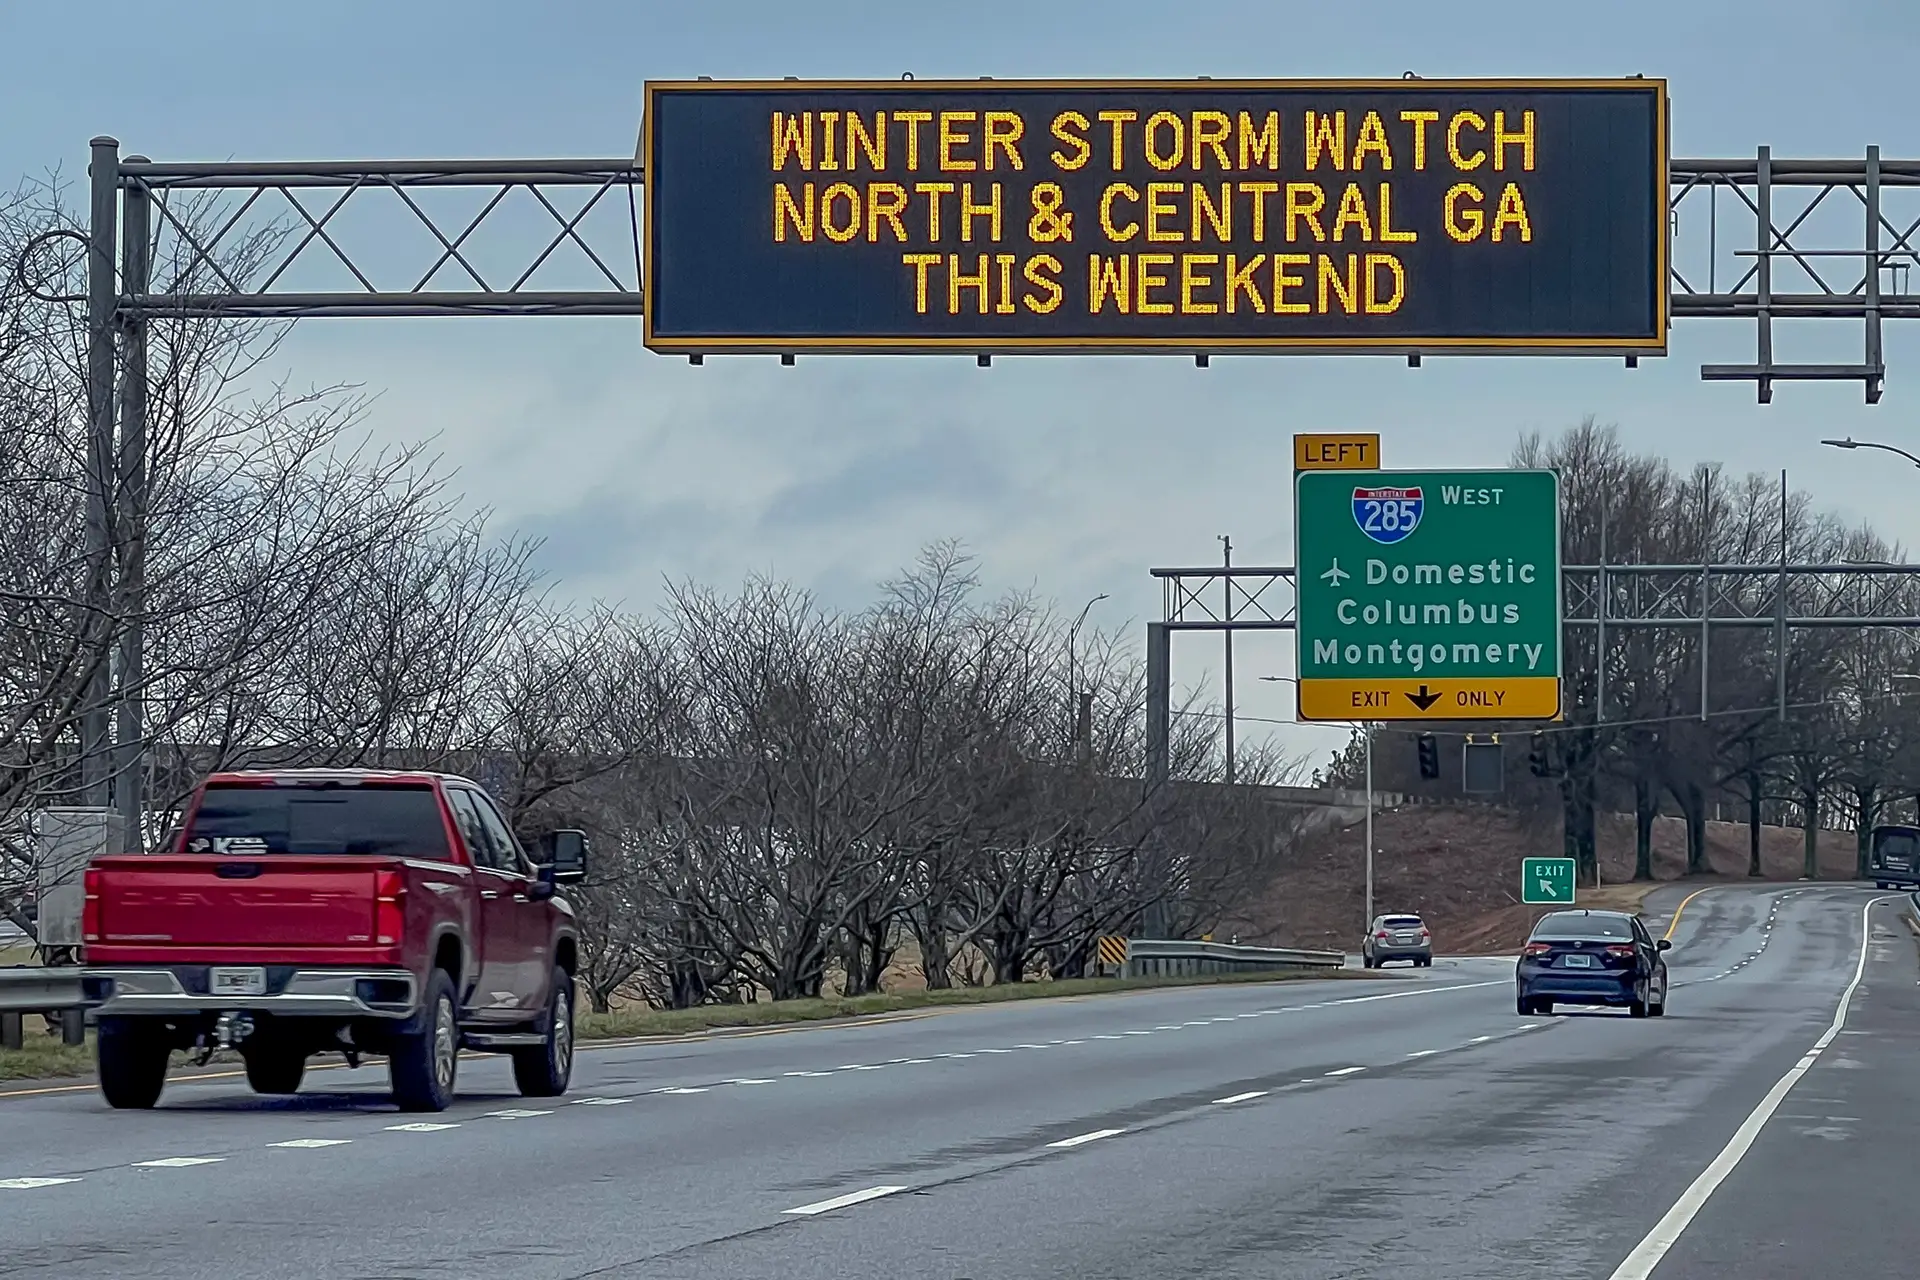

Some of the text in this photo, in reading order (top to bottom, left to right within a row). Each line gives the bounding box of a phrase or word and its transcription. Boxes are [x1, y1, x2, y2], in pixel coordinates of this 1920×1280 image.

[771, 110, 1534, 170] WINTER STORM WATCH
[774, 181, 1531, 242] NORTH & CENTRAL GA
[902, 253, 1404, 314] THIS WEEKEND
[1304, 443, 1368, 463] LEFT
[1367, 490, 1408, 498] INTERSTATE
[1441, 485, 1504, 505] WEST
[1364, 501, 1417, 532] 285
[1366, 558, 1536, 585] Domestic
[1337, 599, 1520, 625] Columbus
[1313, 639, 1543, 672] Montgomery
[1351, 690, 1506, 707] EXIT ONLY
[1535, 865, 1565, 877] EXIT
